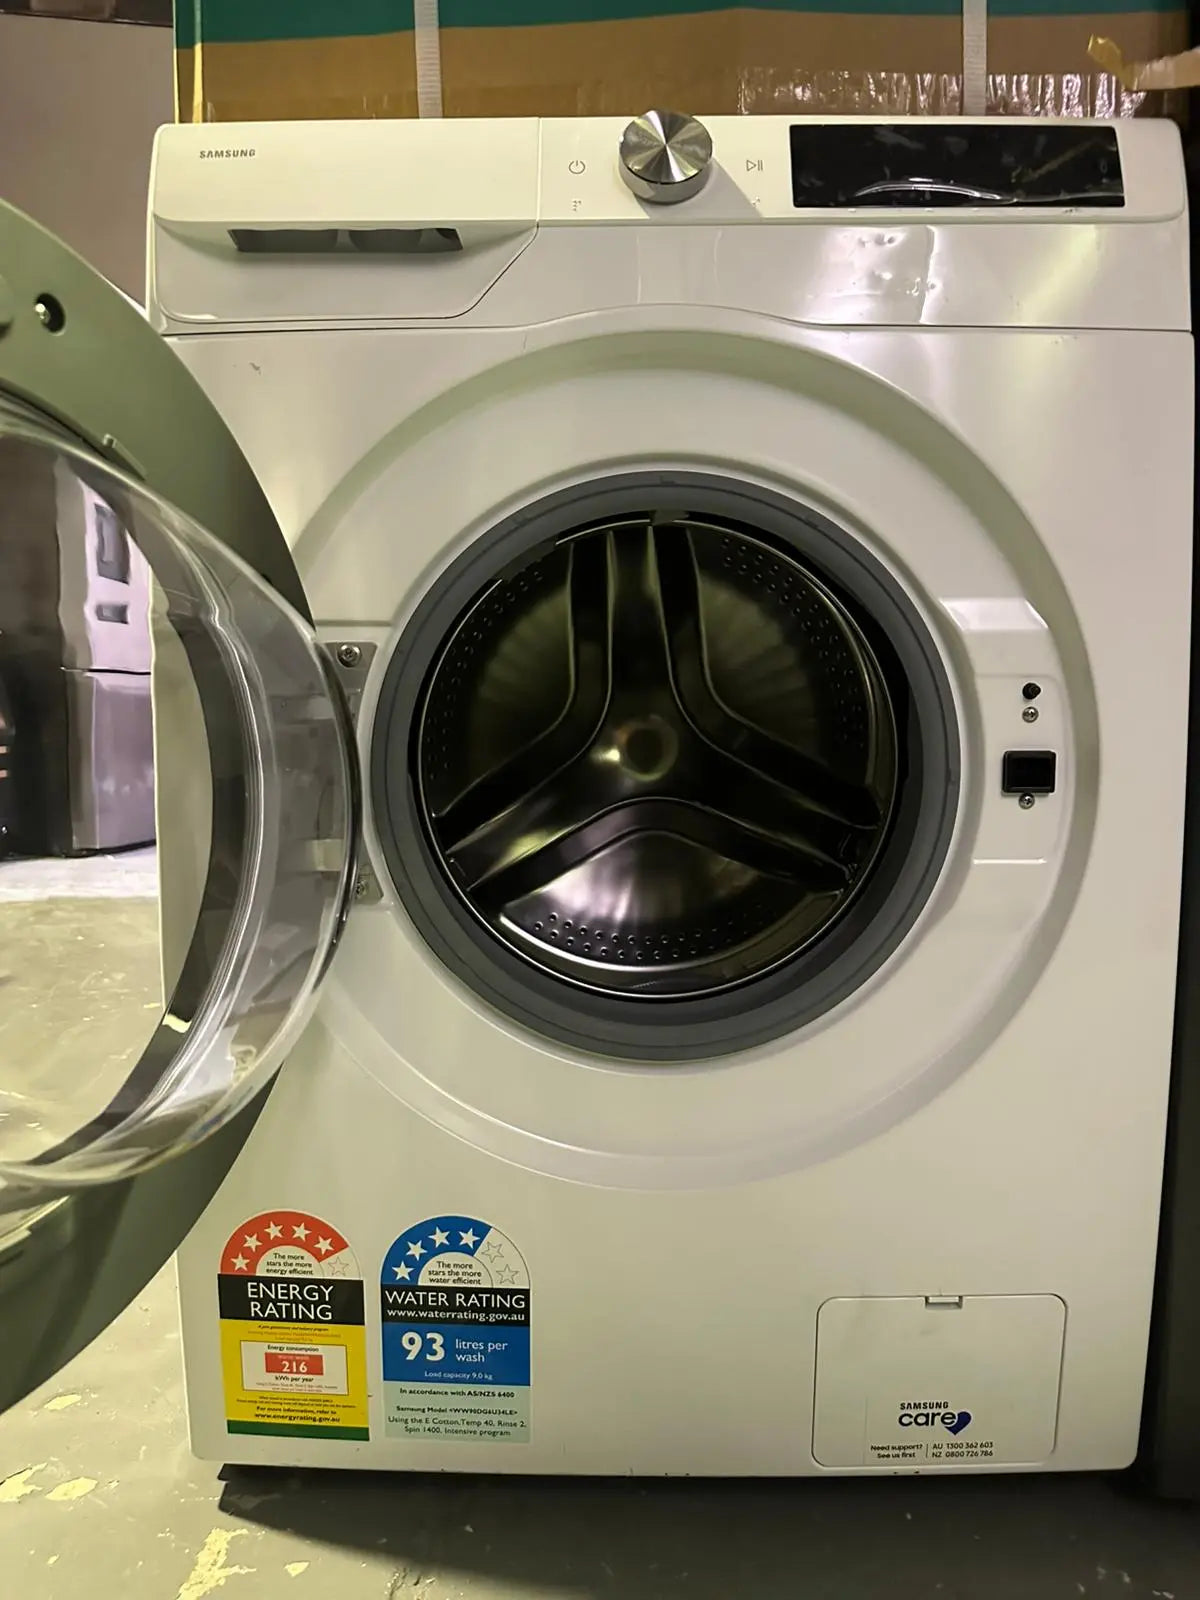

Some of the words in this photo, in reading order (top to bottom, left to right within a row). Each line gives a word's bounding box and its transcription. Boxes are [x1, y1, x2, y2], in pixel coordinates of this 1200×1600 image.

[199, 149, 256, 159] SAMSUNG
[452, 1277, 481, 1285] efficient
[247, 1282, 334, 1301] ENERGY
[385, 1290, 449, 1306] WATER
[456, 1293, 526, 1308] RATING
[250, 1301, 333, 1320] RATING
[387, 1309, 525, 1322] www.waterrating.gov.au
[267, 1344, 285, 1352] Energy
[401, 1331, 446, 1361] 93
[455, 1339, 484, 1350] litres
[487, 1341, 508, 1352] per
[455, 1352, 485, 1362] wash
[281, 1361, 308, 1373] 216
[408, 1388, 449, 1396] accordance
[396, 1405, 425, 1413] Samsung
[900, 1401, 949, 1410] SAMSUNG
[388, 1416, 409, 1424] Using
[497, 1420, 518, 1428] Rinse
[898, 1411, 957, 1427] care
[444, 1427, 477, 1435] Intensive
[479, 1429, 511, 1437] program
[891, 1442, 923, 1452] support?
